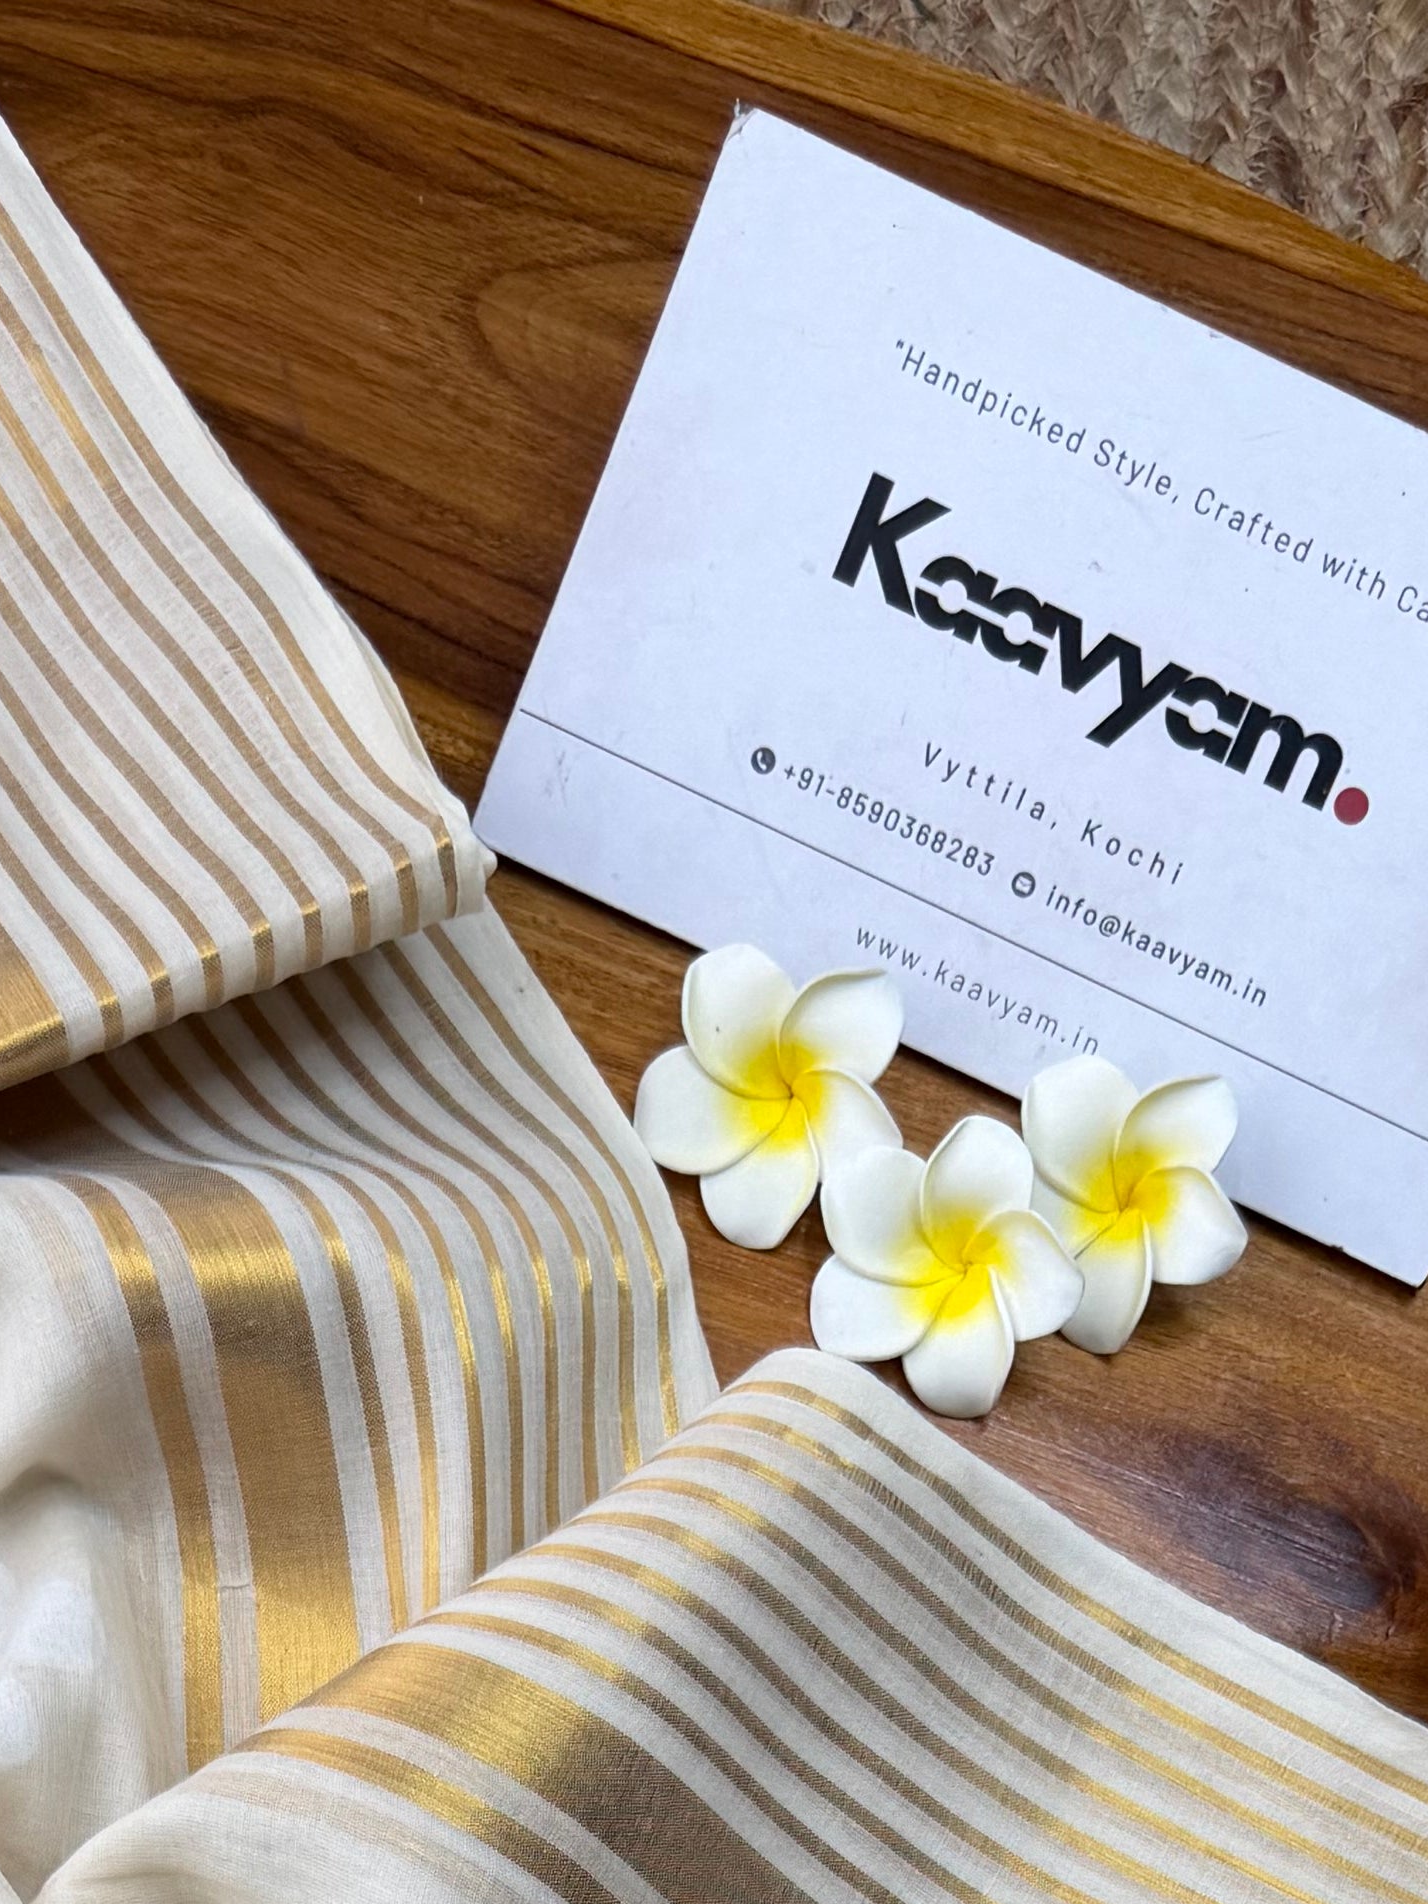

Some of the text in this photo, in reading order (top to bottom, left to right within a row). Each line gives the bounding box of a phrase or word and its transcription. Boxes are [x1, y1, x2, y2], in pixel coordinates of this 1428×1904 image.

[895, 339, 1087, 454] "Handpicked
[1093, 438, 1179, 504] Style,
[1193, 486, 1314, 563] Crafted
[1322, 553, 1386, 599] with
[782, 762, 1268, 1007] +91-8590368283 info@kaavyam.in
[923, 741, 1186, 886] Vyttila, Kochi
[855, 925, 1100, 1056] www.kaavyam.in
